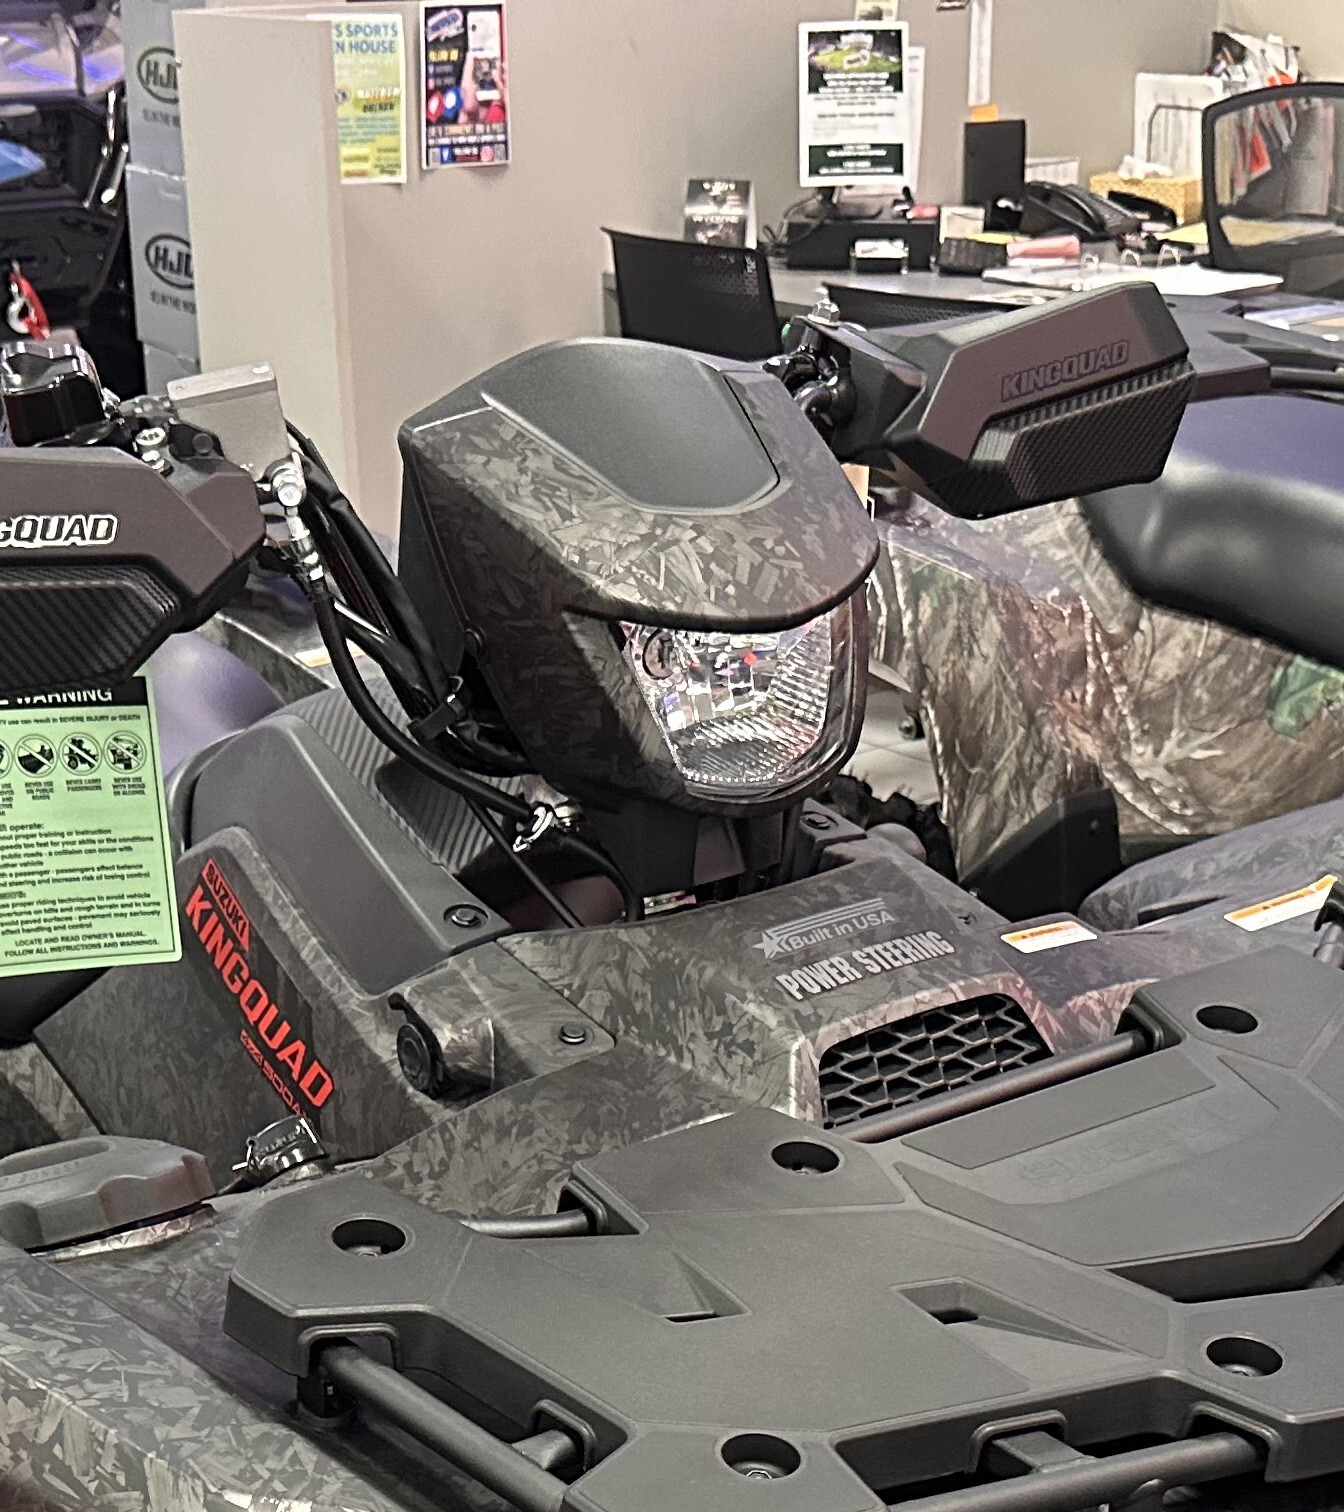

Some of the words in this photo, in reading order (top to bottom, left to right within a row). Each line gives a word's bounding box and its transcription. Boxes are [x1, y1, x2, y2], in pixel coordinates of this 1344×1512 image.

[346, 23, 398, 38] SPORTS
[349, 40, 397, 54] HOUSE
[1000, 339, 1130, 402] KINGQUAD
[205, 863, 249, 937] SUZUKI
[14, 938, 42, 946] LOCATE
[787, 928, 833, 951] Built
[835, 921, 854, 937] in
[855, 910, 897, 931] USA
[775, 956, 863, 1001] POWER
[851, 930, 955, 975] STEERING
[185, 884, 335, 1108] KINGQUAD
